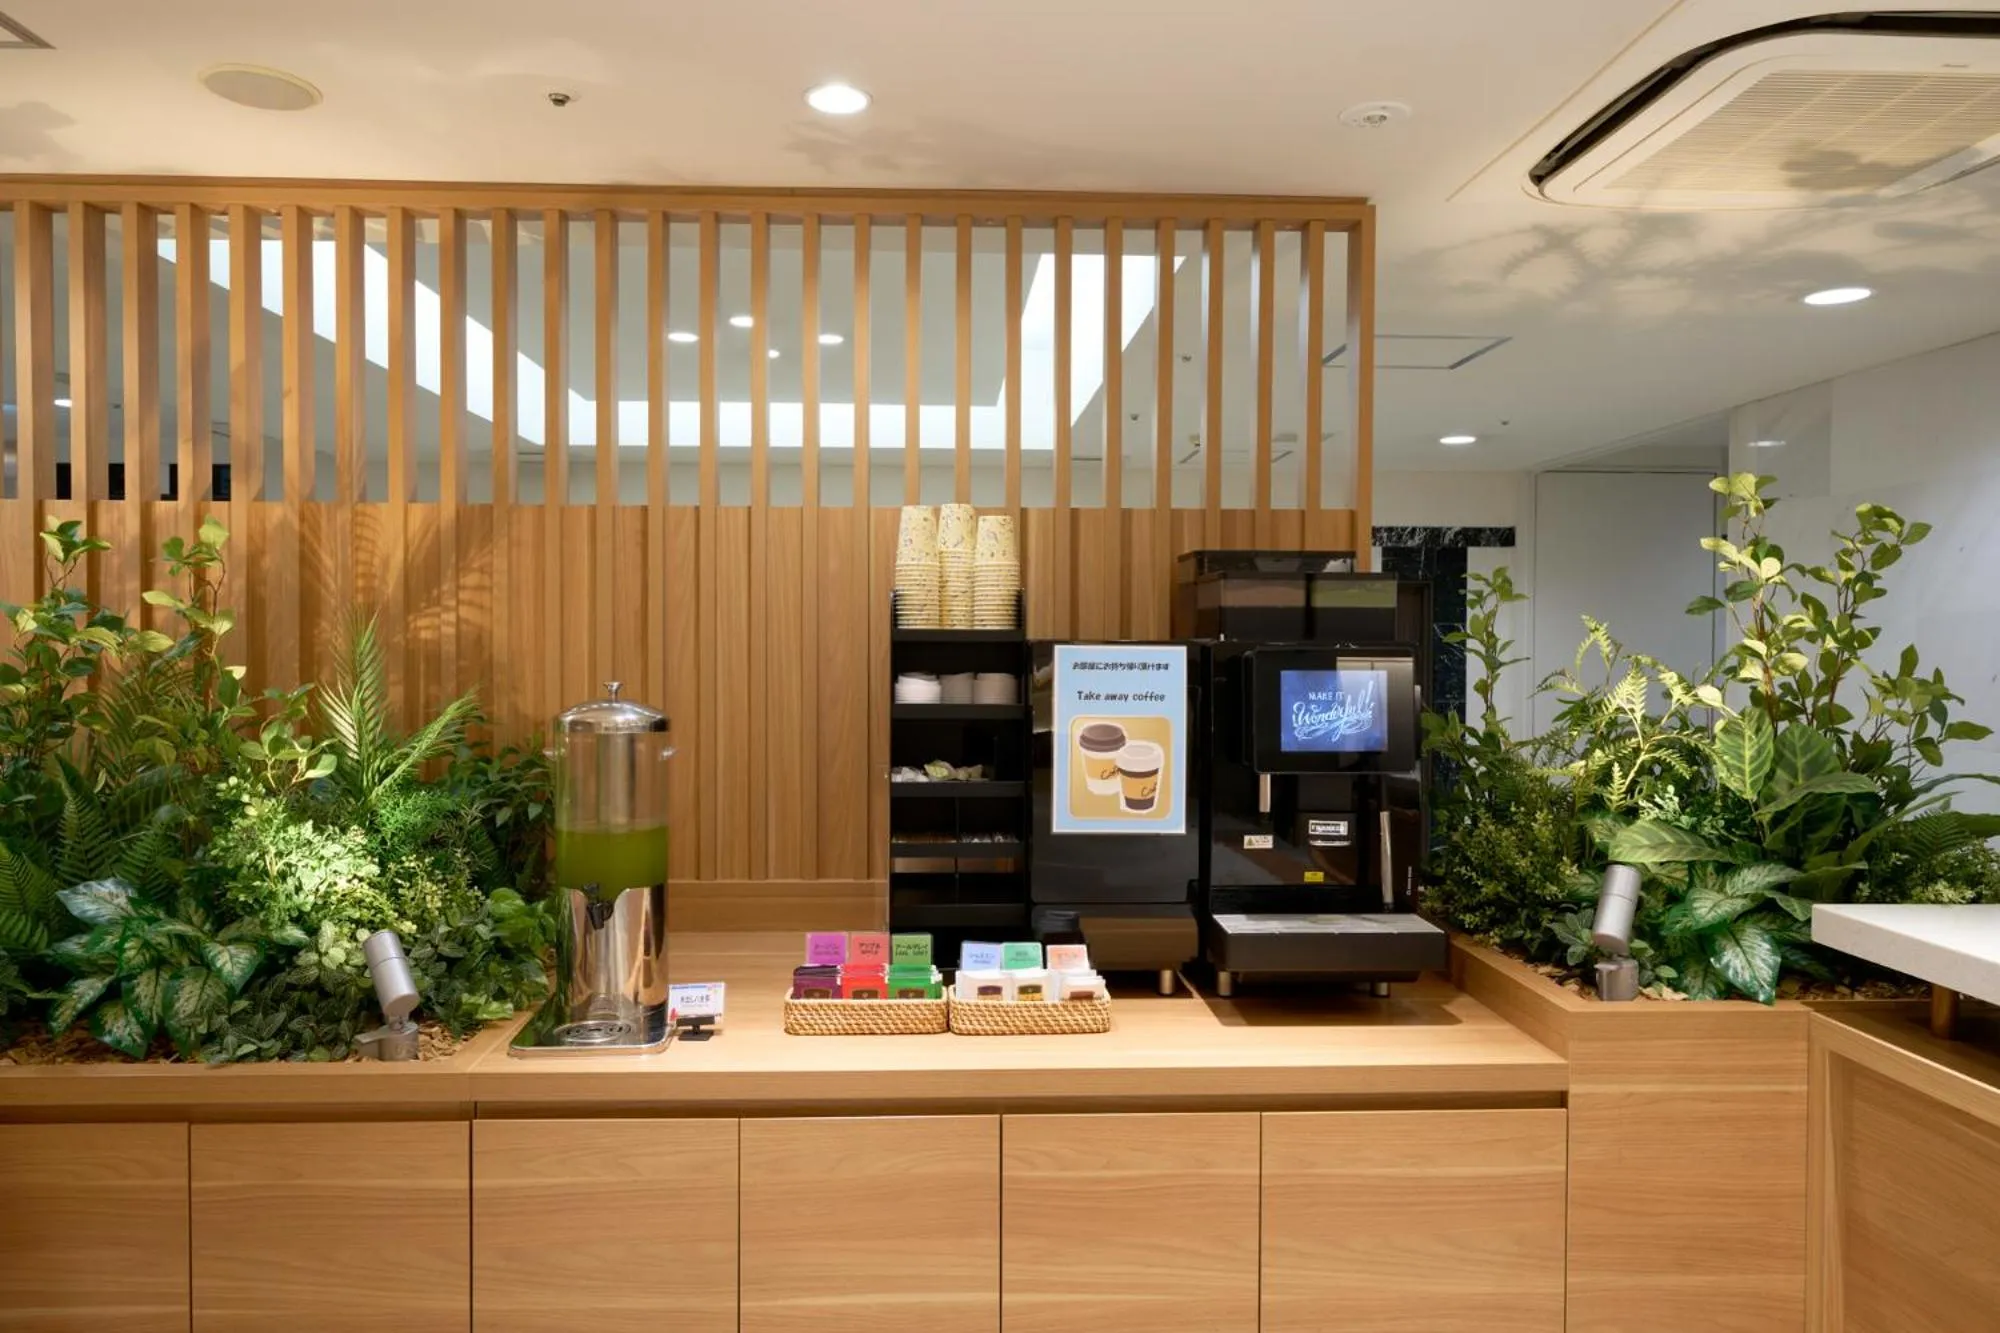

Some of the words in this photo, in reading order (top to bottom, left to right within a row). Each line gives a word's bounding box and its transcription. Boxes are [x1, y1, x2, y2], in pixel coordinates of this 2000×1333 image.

[1077, 690, 1101, 701] Take
[1104, 692, 1129, 702] away
[1132, 690, 1166, 702] coffee
[1308, 691, 1333, 701] MAKE
[1335, 691, 1345, 701] IT
